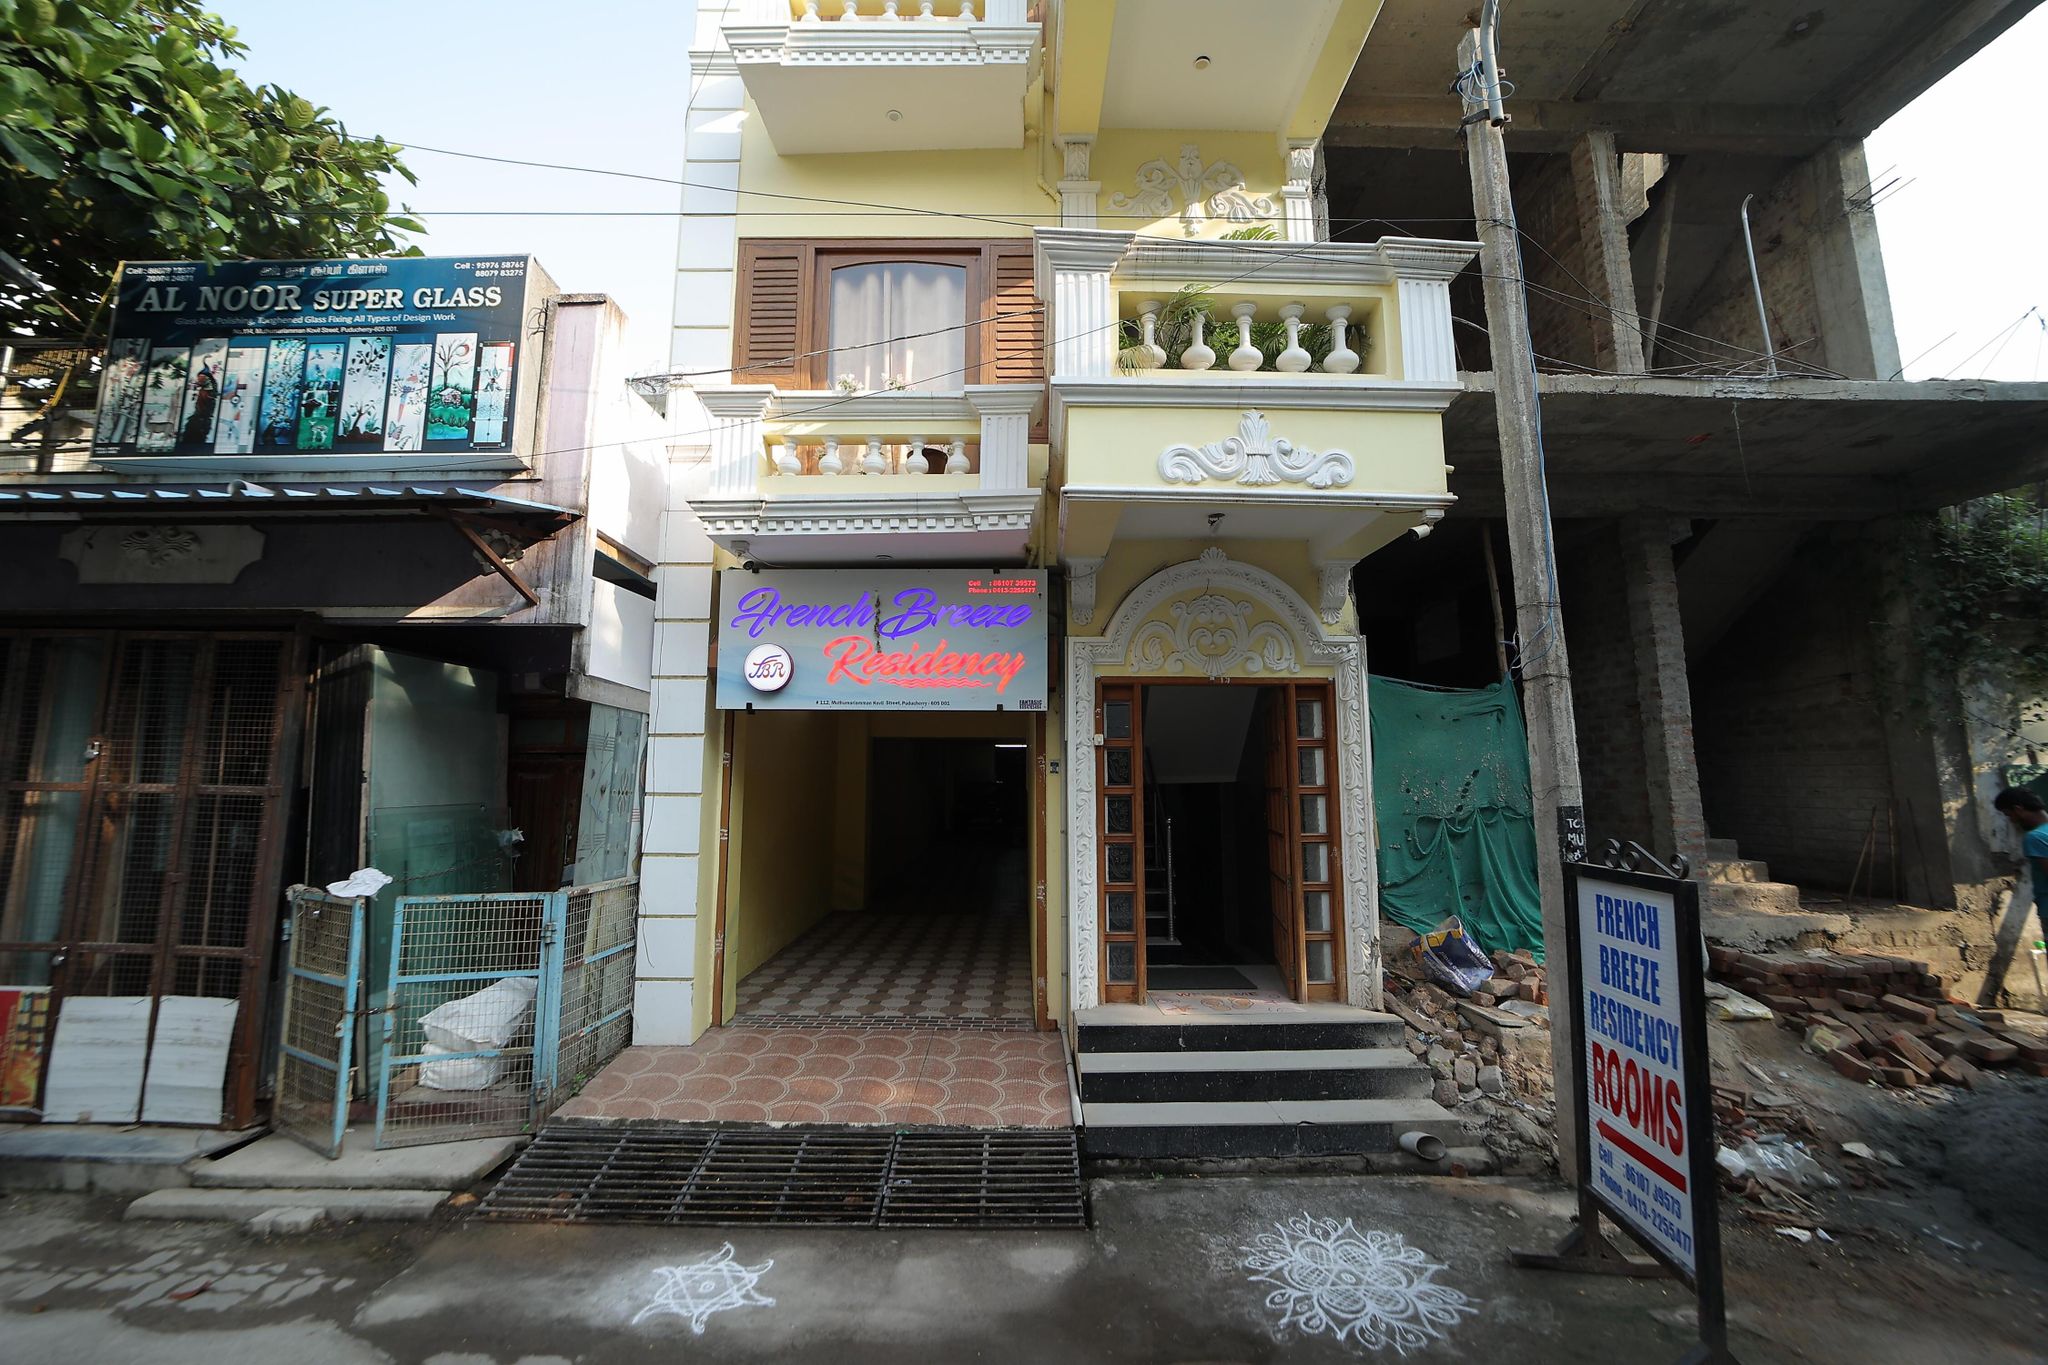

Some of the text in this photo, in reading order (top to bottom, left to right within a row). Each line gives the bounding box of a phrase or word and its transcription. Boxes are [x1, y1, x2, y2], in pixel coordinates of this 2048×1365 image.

[454, 262, 471, 270] Cell
[501, 261, 525, 269] 58765
[135, 285, 503, 312] AL NOOR SUPER GLASS
[304, 316, 327, 324] Glass
[328, 315, 353, 324] Fixing
[367, 314, 392, 323] Types
[393, 314, 402, 322] of
[403, 314, 431, 323] Design
[433, 313, 456, 321] Work
[731, 586, 1034, 640] French Breeze
[823, 635, 1026, 695] Residency
[1595, 893, 1661, 950] FRENCH
[1599, 943, 1661, 1007] BREEZE
[1589, 989, 1680, 1072] RESIDENCY
[1591, 1040, 1684, 1157] ROOMS
[1598, 1142, 1614, 1169] Cell
[1653, 1183, 1682, 1220] 39573
[1599, 1166, 1623, 1200] Phone
